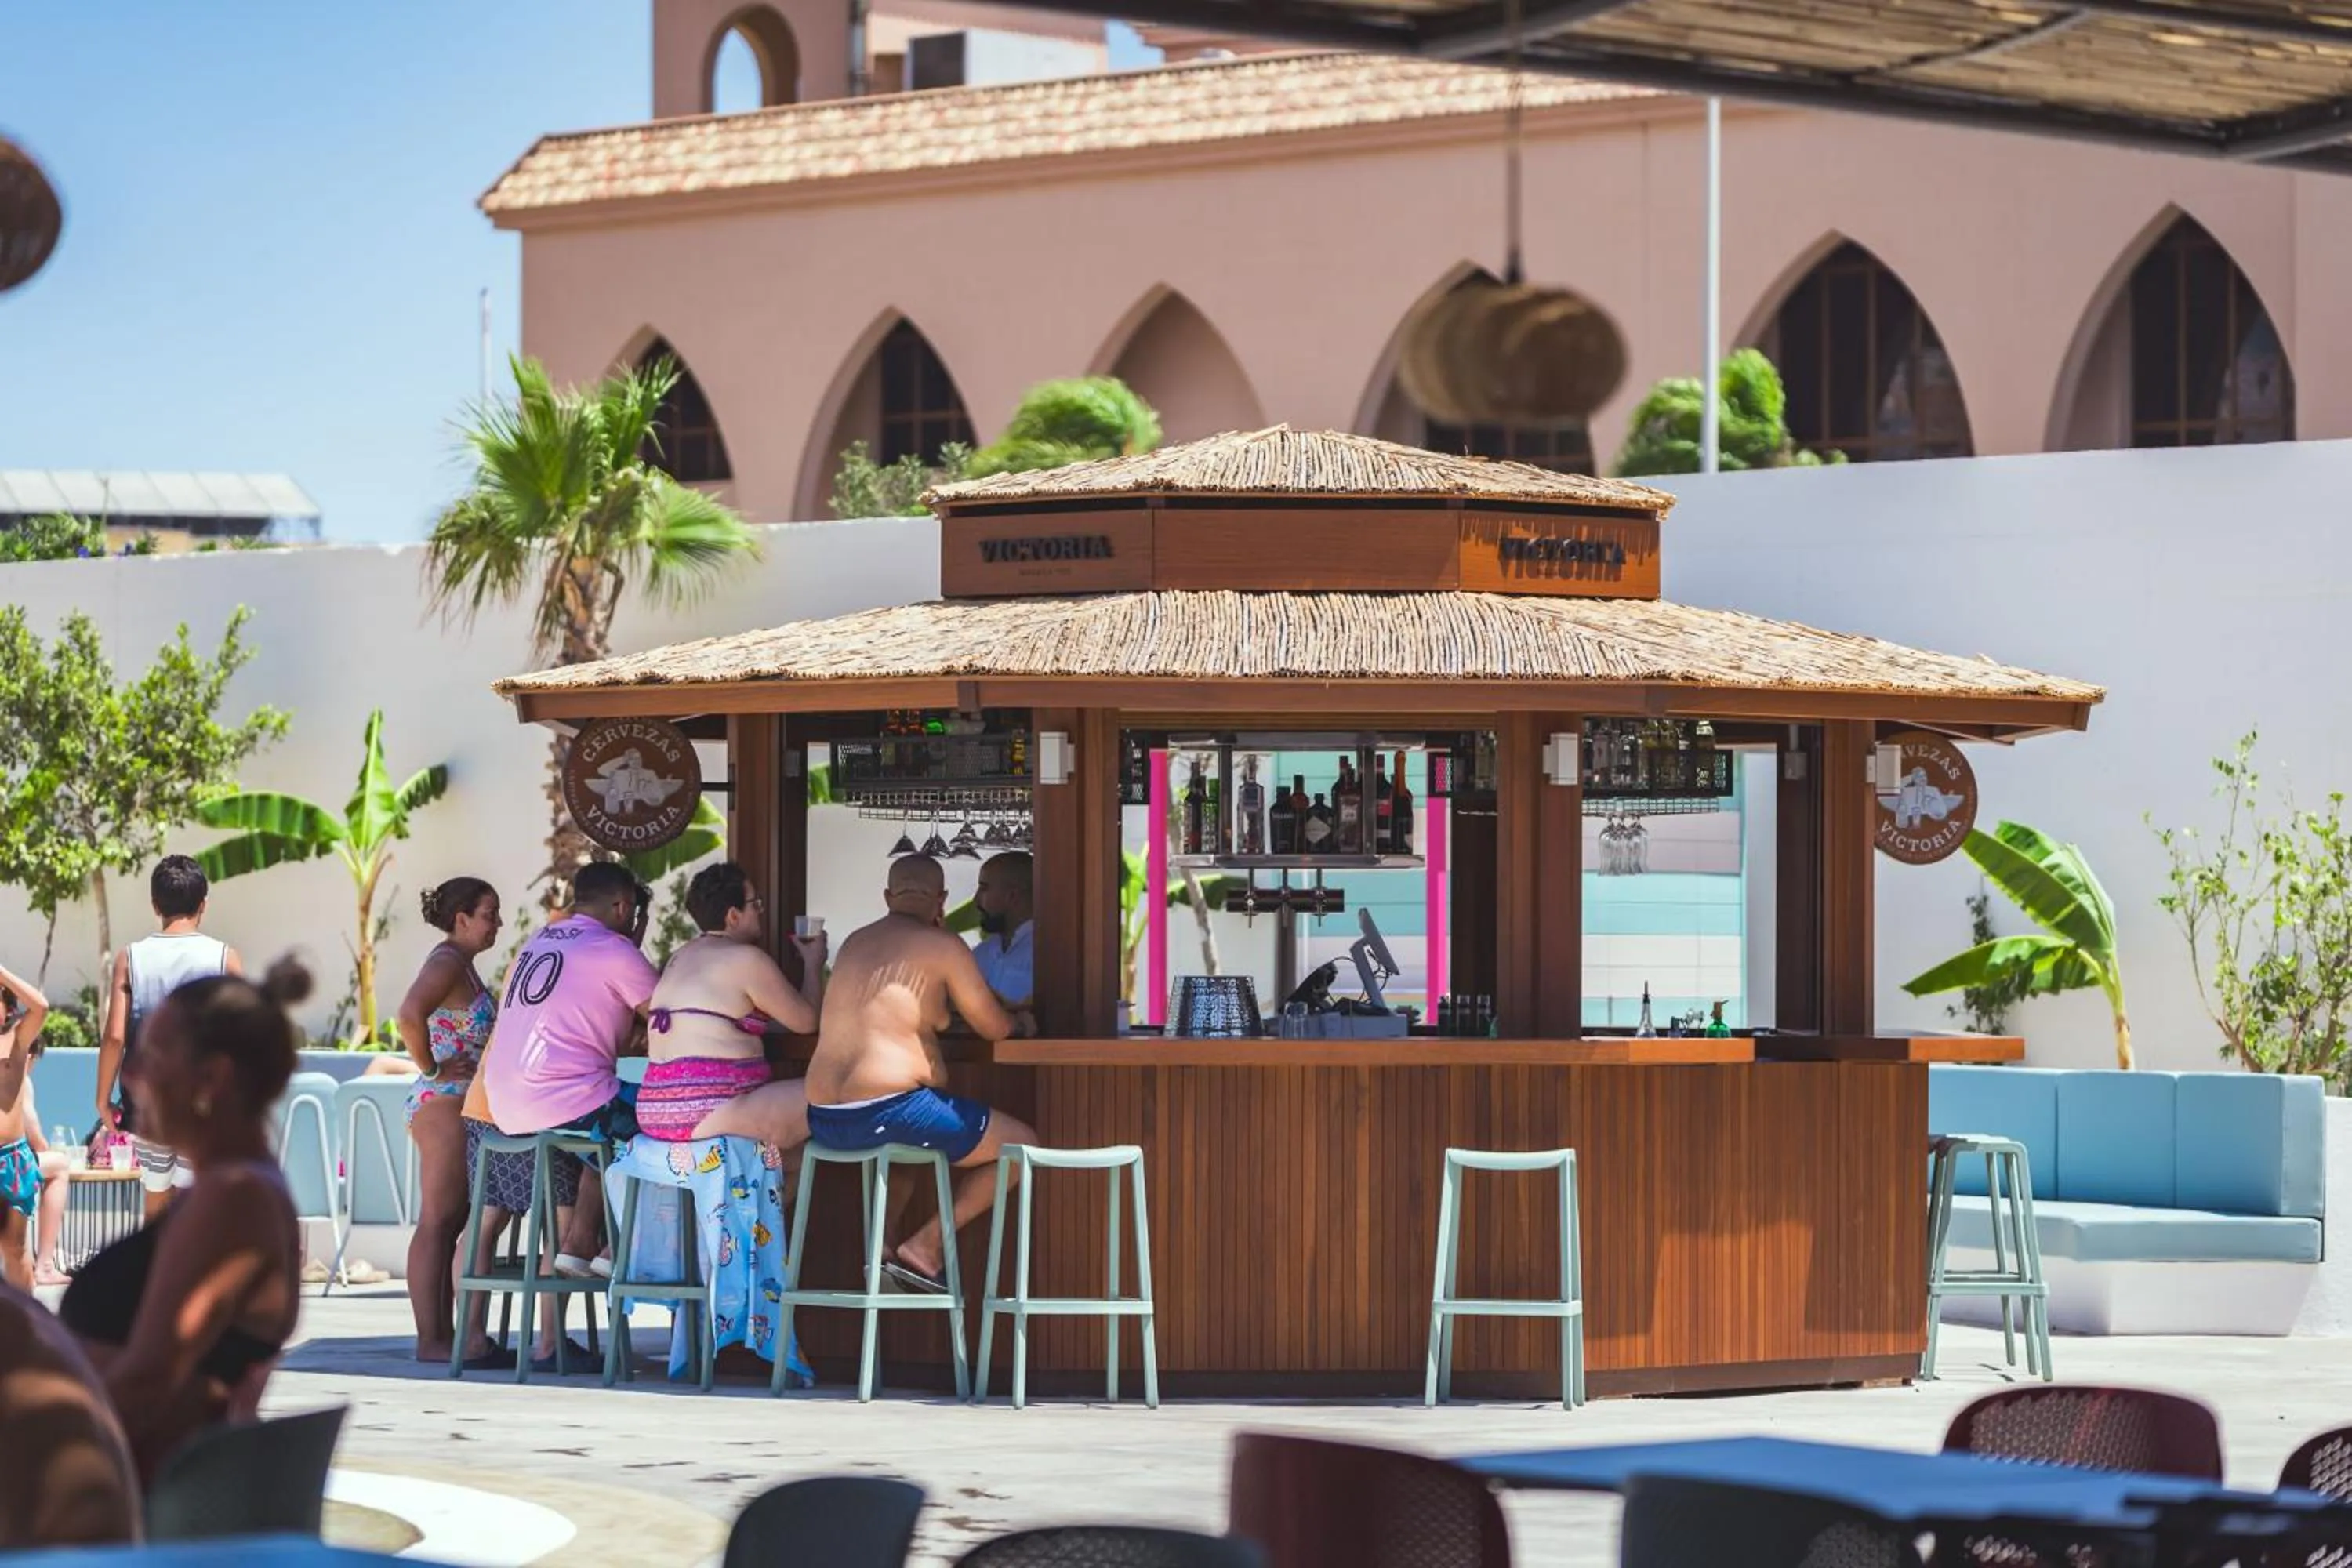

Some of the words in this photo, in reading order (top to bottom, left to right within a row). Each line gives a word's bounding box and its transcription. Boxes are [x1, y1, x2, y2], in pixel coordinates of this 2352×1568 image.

[980, 535, 1113, 563] VICTORIA
[582, 724, 680, 762] CERVEZAS
[1901, 745, 1961, 780] VEZAS
[587, 804, 680, 840] VICTORIA
[1881, 819, 1961, 851] VICTORIA
[505, 950, 563, 1008] 10
